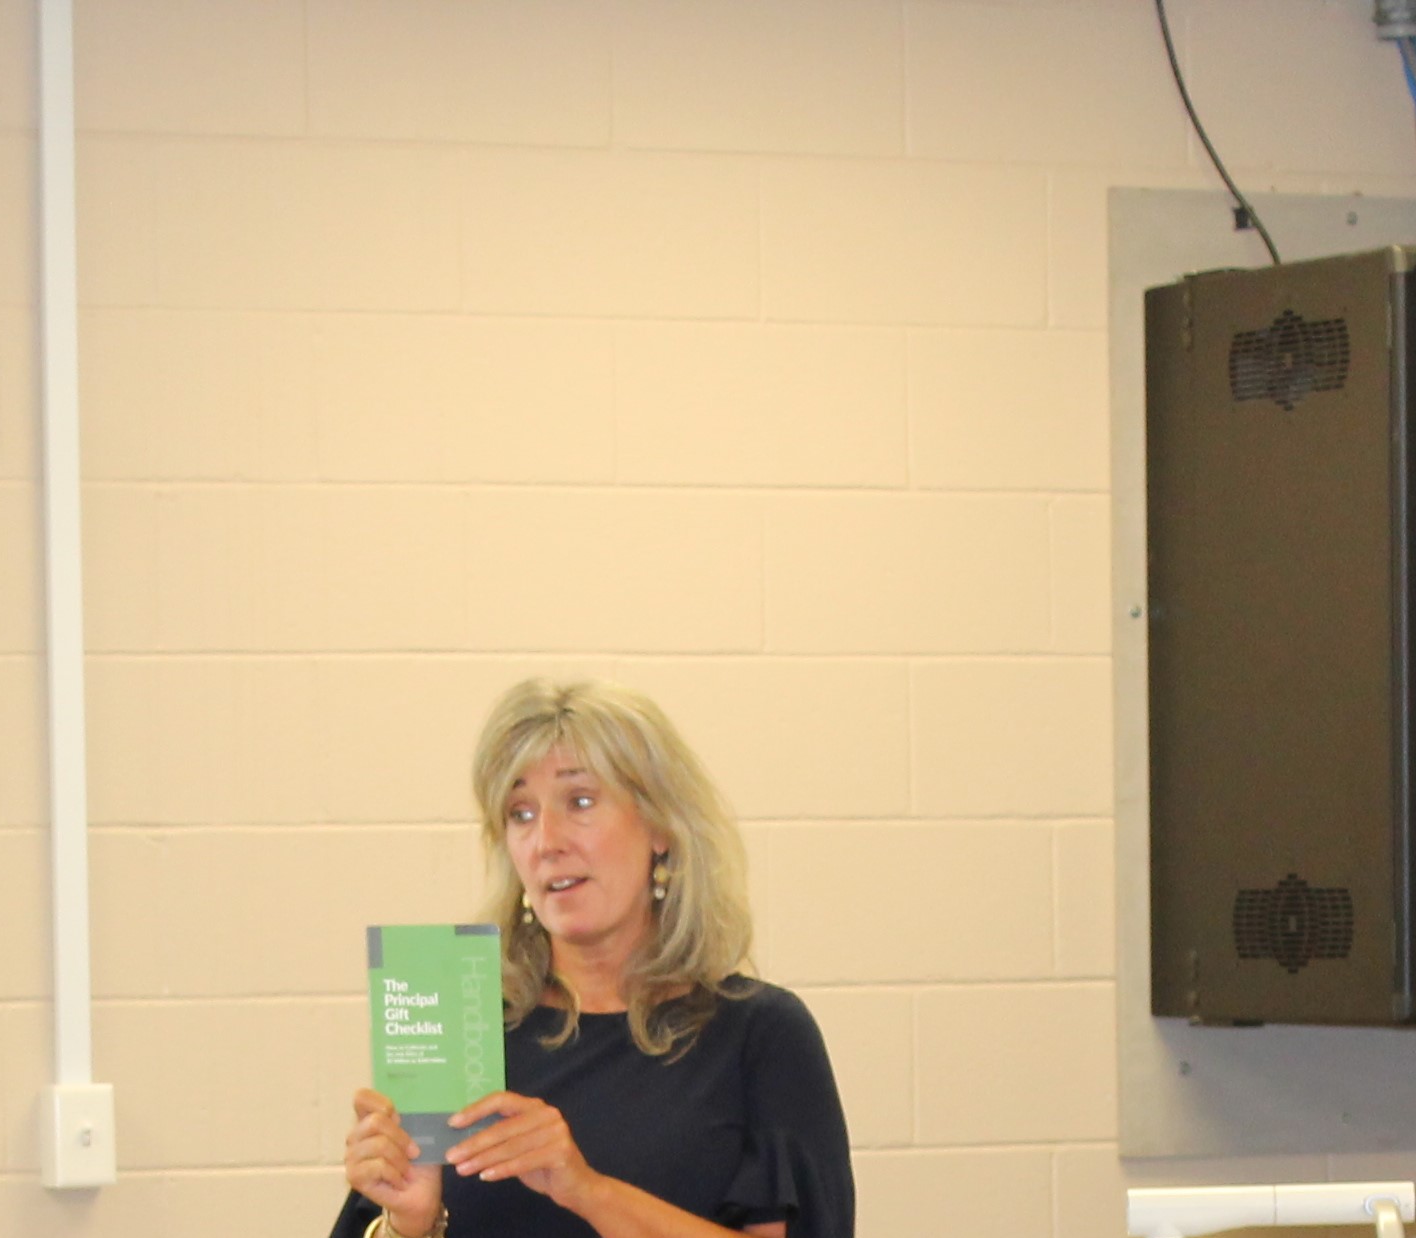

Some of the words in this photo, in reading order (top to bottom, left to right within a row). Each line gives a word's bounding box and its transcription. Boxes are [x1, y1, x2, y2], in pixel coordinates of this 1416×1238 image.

[384, 978, 409, 991] The
[384, 993, 439, 1008] Principal
[385, 1008, 410, 1021] Gift
[385, 1022, 443, 1035] Checklist
